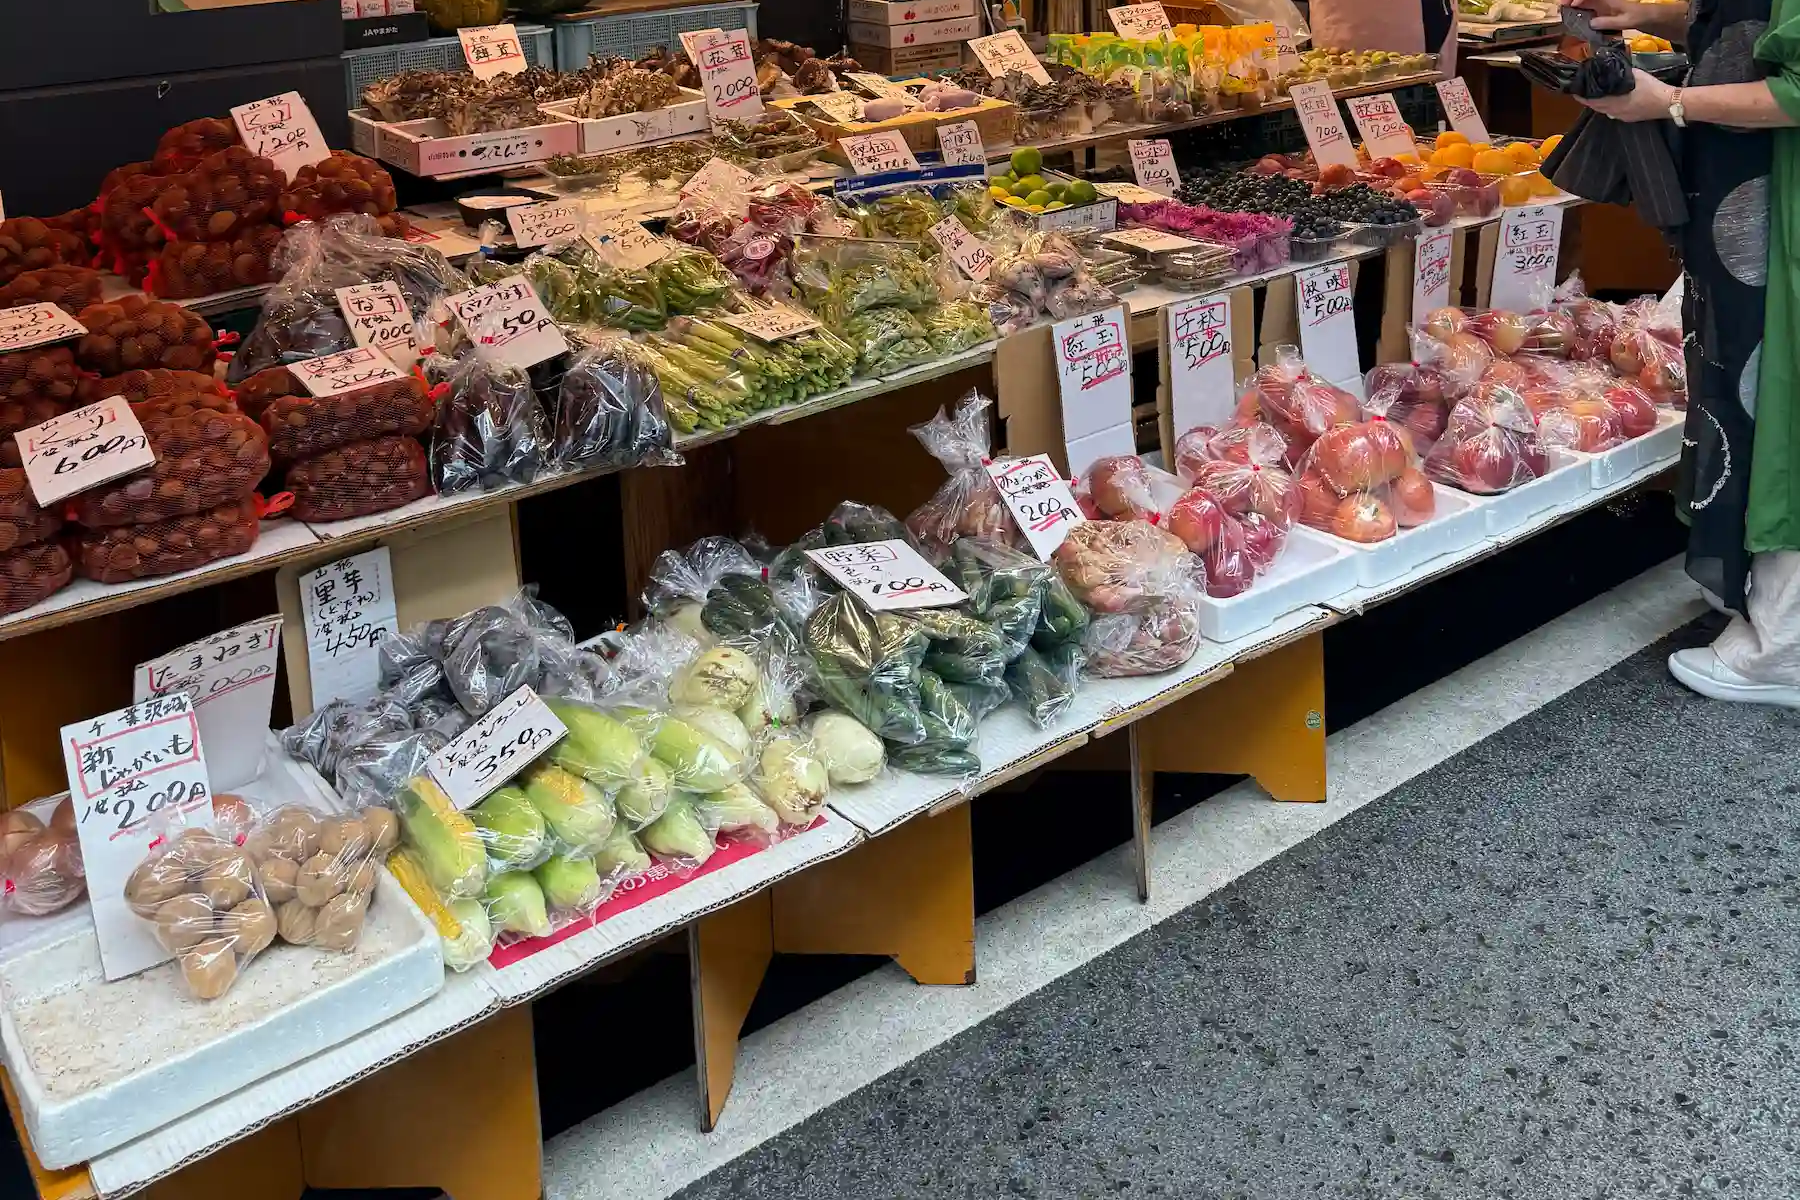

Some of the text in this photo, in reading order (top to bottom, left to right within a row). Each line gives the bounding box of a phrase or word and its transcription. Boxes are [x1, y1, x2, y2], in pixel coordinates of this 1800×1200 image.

[362, 25, 399, 38] JAやまがた
[713, 76, 759, 103] 2000円
[1073, 313, 1105, 329] 山形
[1066, 328, 1113, 358] 紅玉
[1081, 356, 1128, 385] 500円
[53, 434, 147, 476] 600円
[1019, 497, 1078, 522] 200円
[314, 559, 354, 581] 山形
[314, 569, 364, 607] 里芋
[872, 576, 948, 595] 100円
[325, 622, 387, 658] 450円
[155, 628, 269, 688] たまねぎ
[474, 726, 553, 784] 350円
[112, 779, 207, 831] 200円
